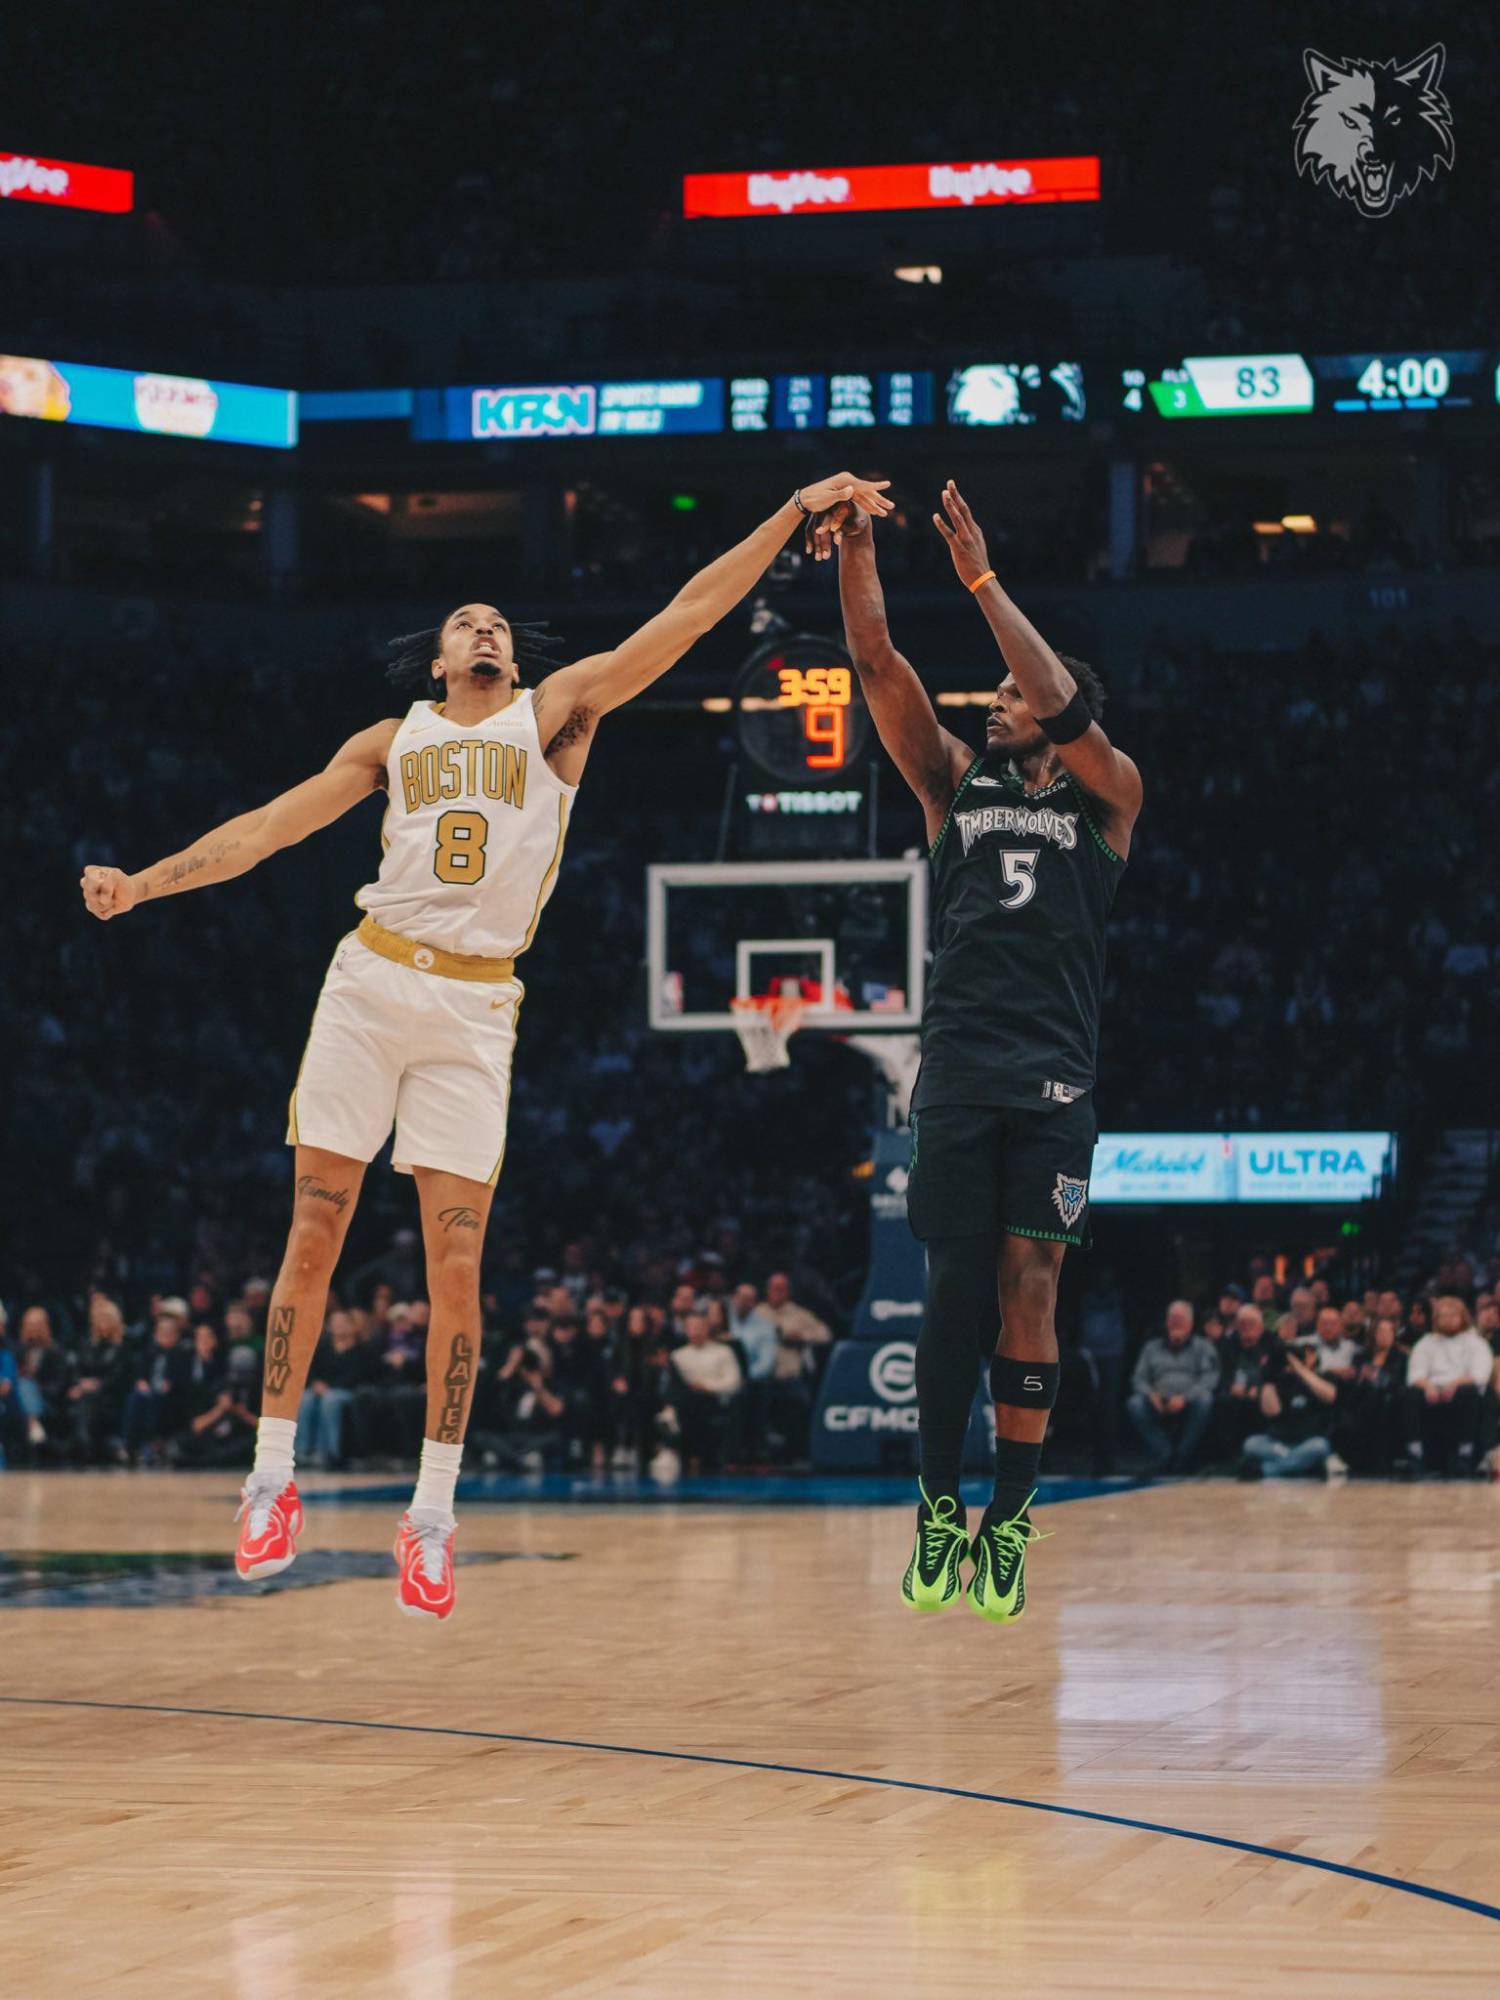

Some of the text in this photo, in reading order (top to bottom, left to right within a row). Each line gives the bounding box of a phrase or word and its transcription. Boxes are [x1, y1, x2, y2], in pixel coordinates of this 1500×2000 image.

[1237, 366, 1281, 399] 83
[1358, 357, 1450, 399] 4:00
[806, 705, 844, 769] 9
[400, 740, 527, 814] BOSTON
[1033, 780, 1068, 800] sezzle
[434, 810, 488, 885] 8
[954, 805, 1080, 857] TIMBERWOLVES
[999, 850, 1040, 909] 5
[1250, 1150, 1366, 1175] ULTRA
[298, 1175, 349, 1215] Family
[265, 1307, 295, 1394] NOW
